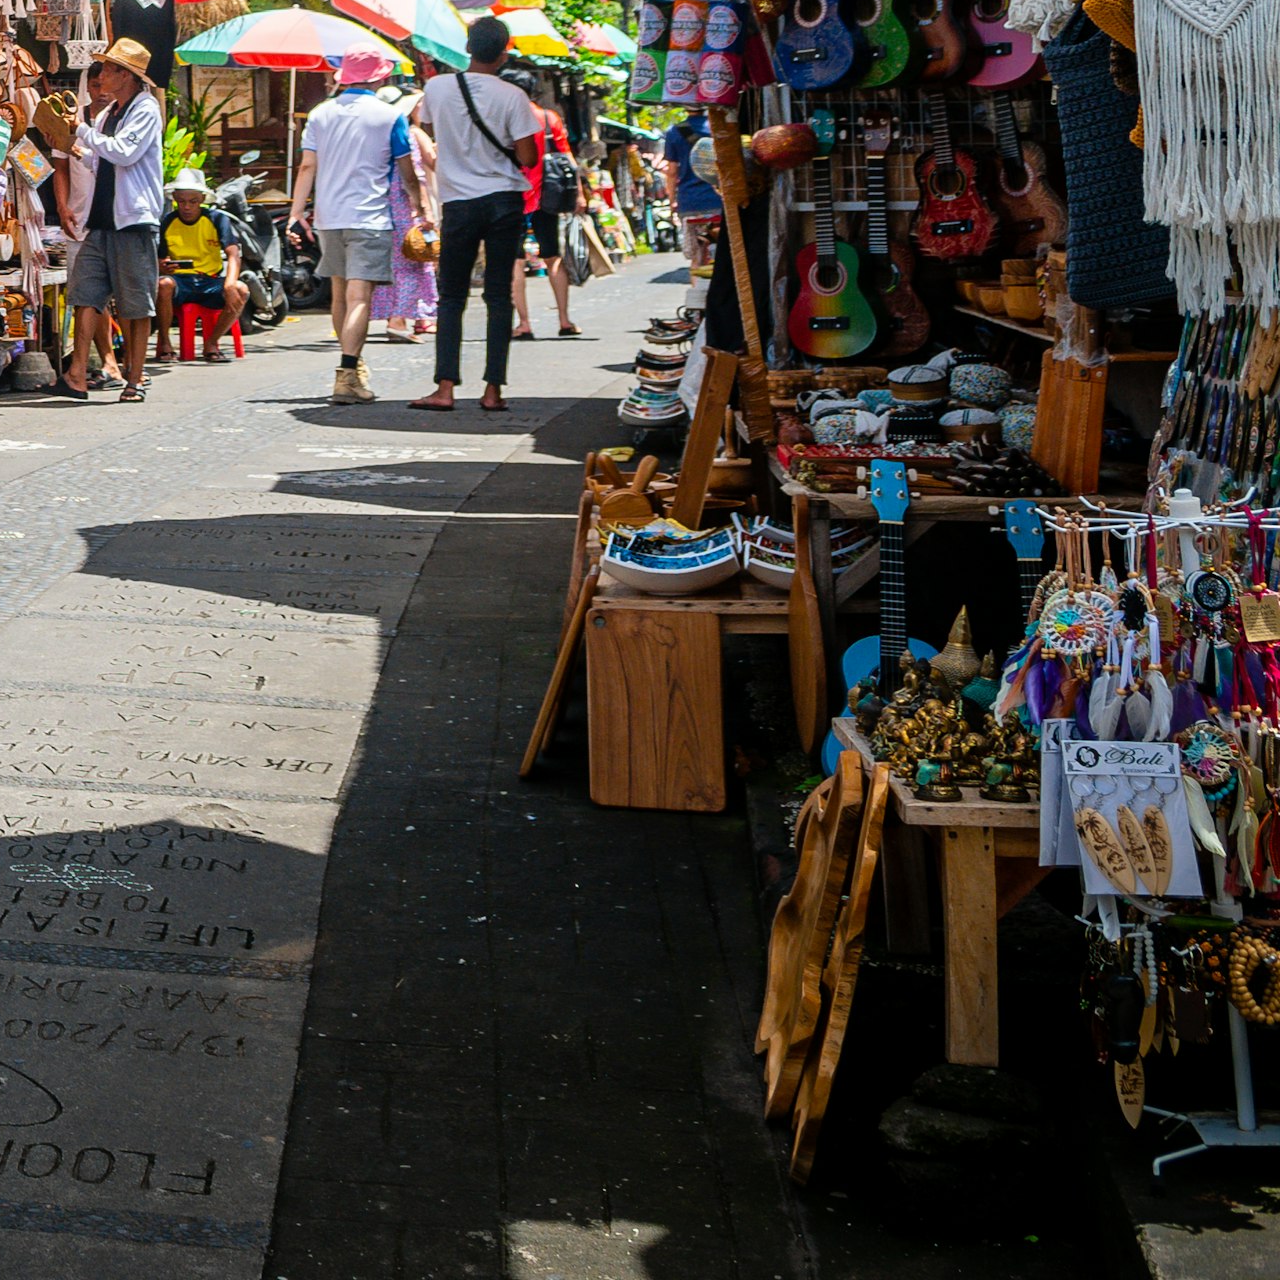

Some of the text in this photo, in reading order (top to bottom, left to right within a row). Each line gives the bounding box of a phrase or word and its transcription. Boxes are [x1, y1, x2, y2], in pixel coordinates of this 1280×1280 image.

[259, 758, 334, 775] DEK
[1103, 747, 1164, 766] Bali
[108, 850, 140, 867] A
[150, 854, 250, 874] NOT
[40, 889, 106, 911] BE
[121, 894, 178, 915] TO
[25, 911, 60, 933] A
[73, 916, 118, 938] IS
[139, 920, 257, 951] LIFE
